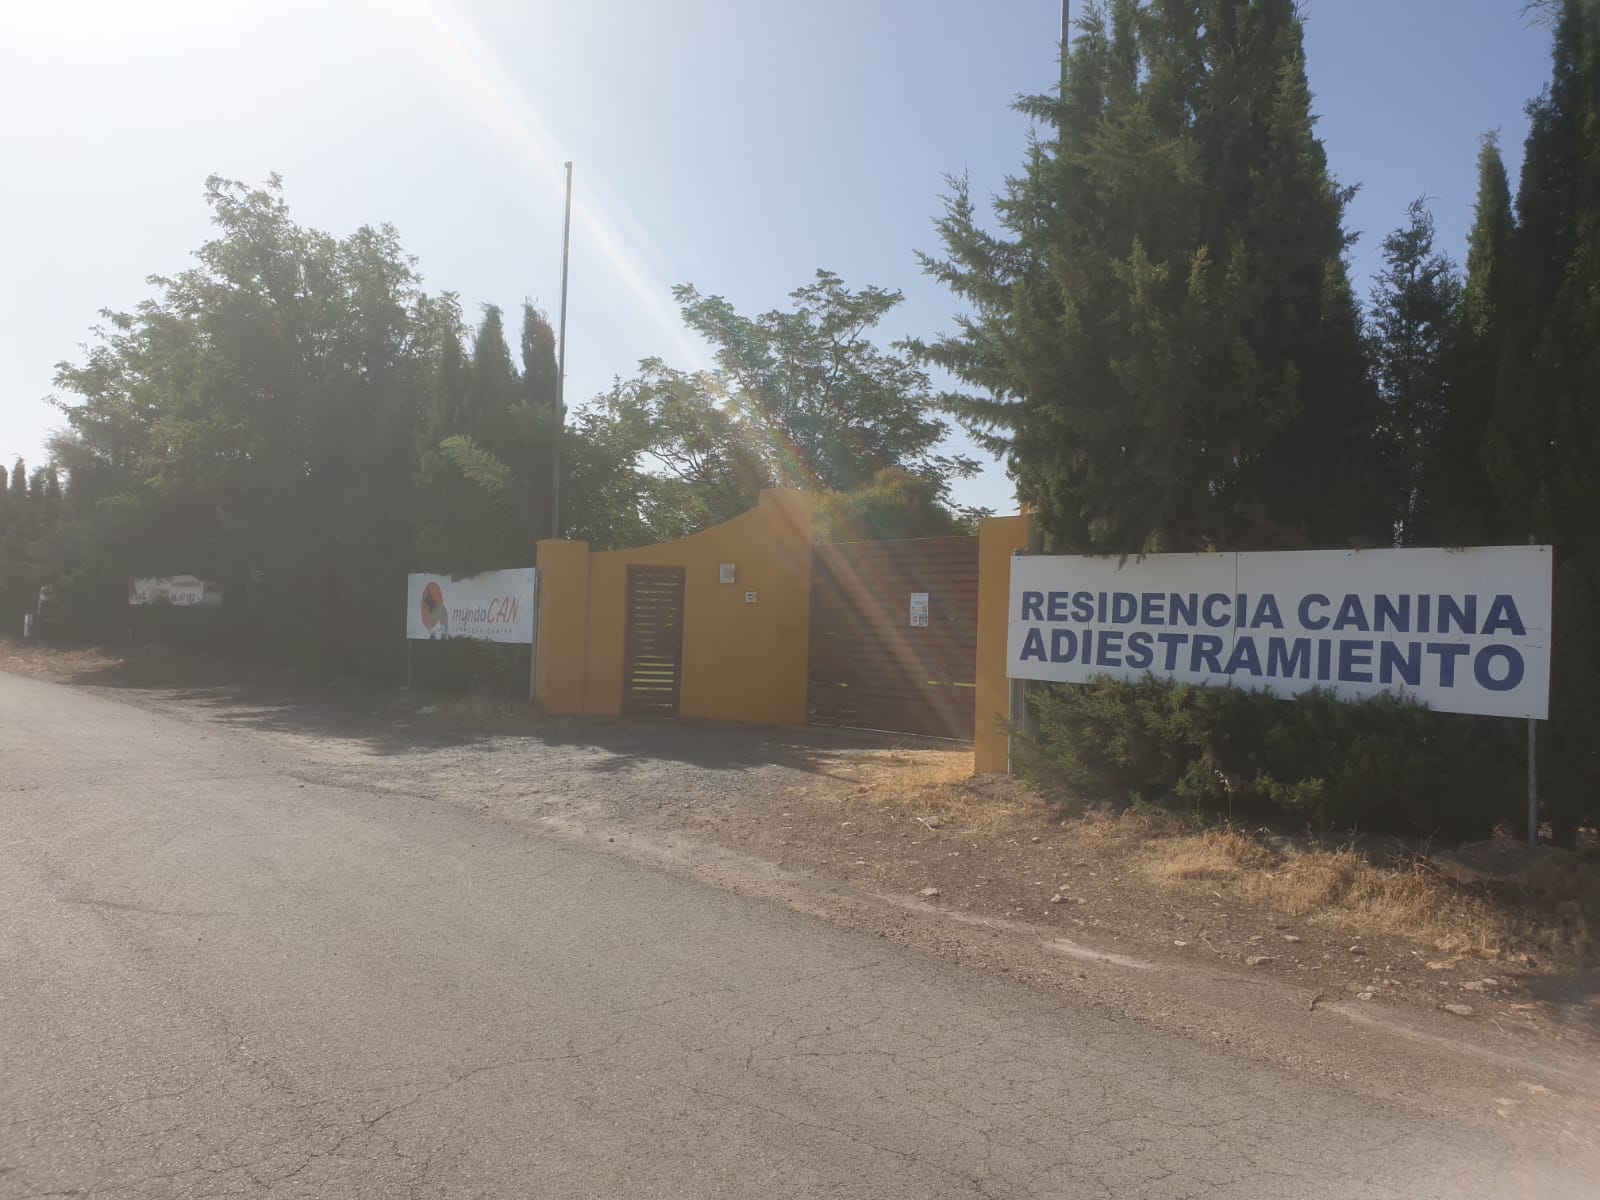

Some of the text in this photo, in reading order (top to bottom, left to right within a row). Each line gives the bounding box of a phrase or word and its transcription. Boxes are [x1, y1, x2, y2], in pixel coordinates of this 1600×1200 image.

[1021, 591, 1527, 636] RESIDENCIA CANINA
[1019, 627, 1525, 692] ADIESTRAMIENTO
